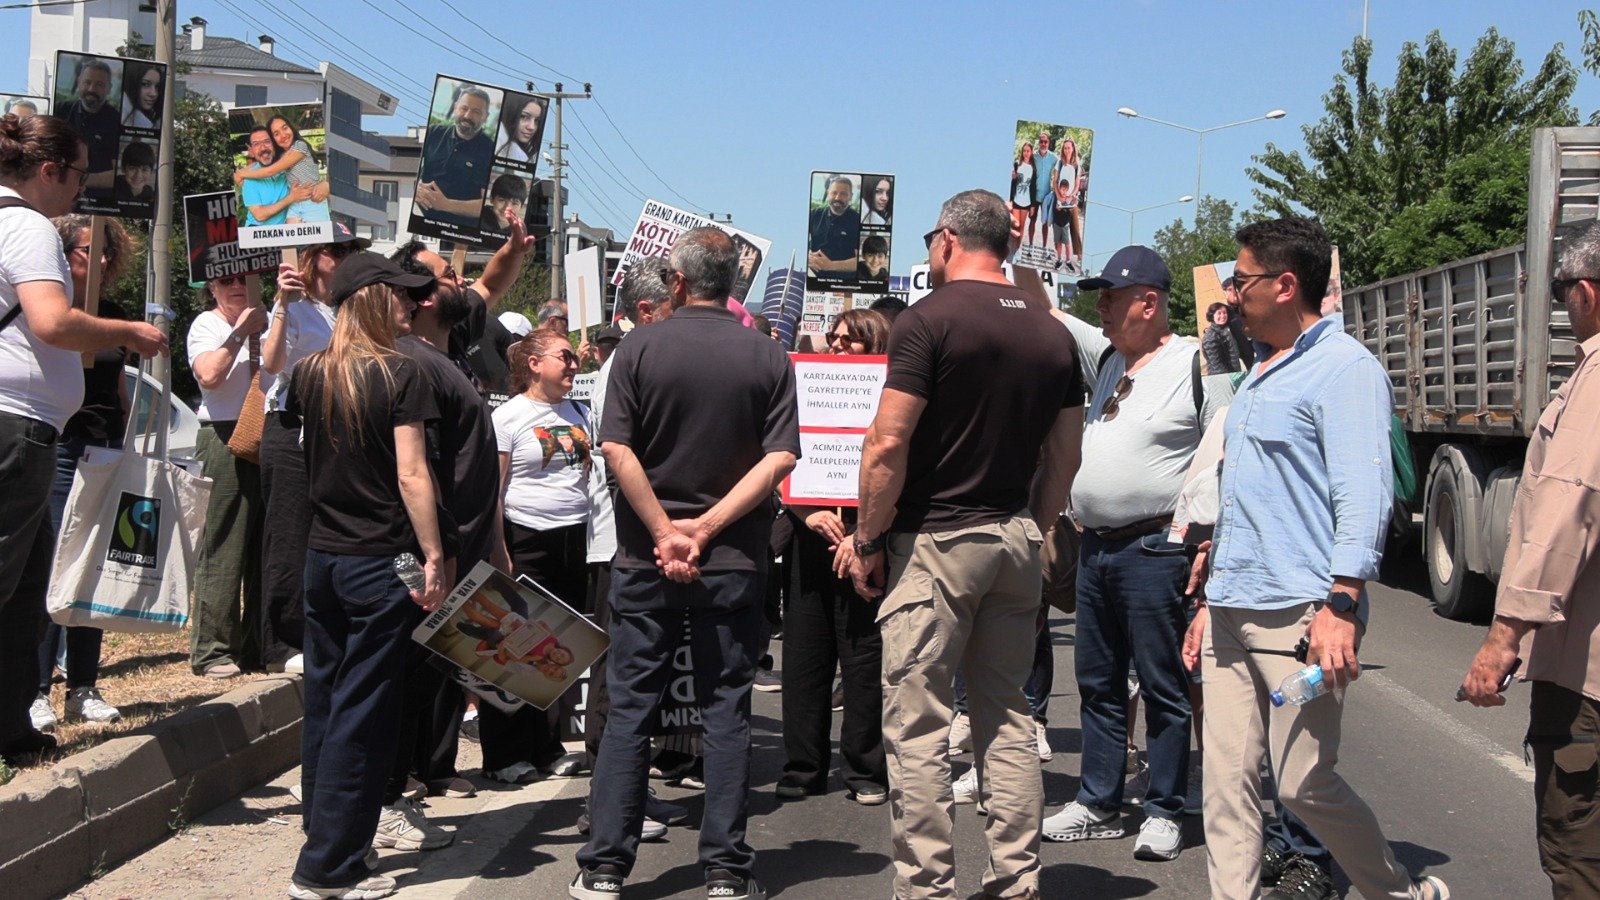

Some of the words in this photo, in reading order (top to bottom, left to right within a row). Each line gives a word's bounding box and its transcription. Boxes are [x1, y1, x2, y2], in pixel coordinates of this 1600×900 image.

[645, 202, 672, 222] GRAND
[252, 228, 284, 240] ATAKAN
[285, 229, 295, 237] ve
[297, 226, 322, 236] DERİN
[205, 260, 249, 279] ÜSTÜN
[803, 372, 879, 382] KARTALKAYA'DAN
[807, 386, 873, 396] GAYRETTEPE'YE
[807, 401, 849, 410] İHMALLER
[850, 402, 871, 410] AYNI
[812, 443, 842, 452] ACIMIZ
[844, 444, 862, 452] AYN
[809, 457, 860, 466] TALEPLERİM
[826, 472, 848, 480] AYNI
[109, 549, 155, 565] FAIRTRADE
